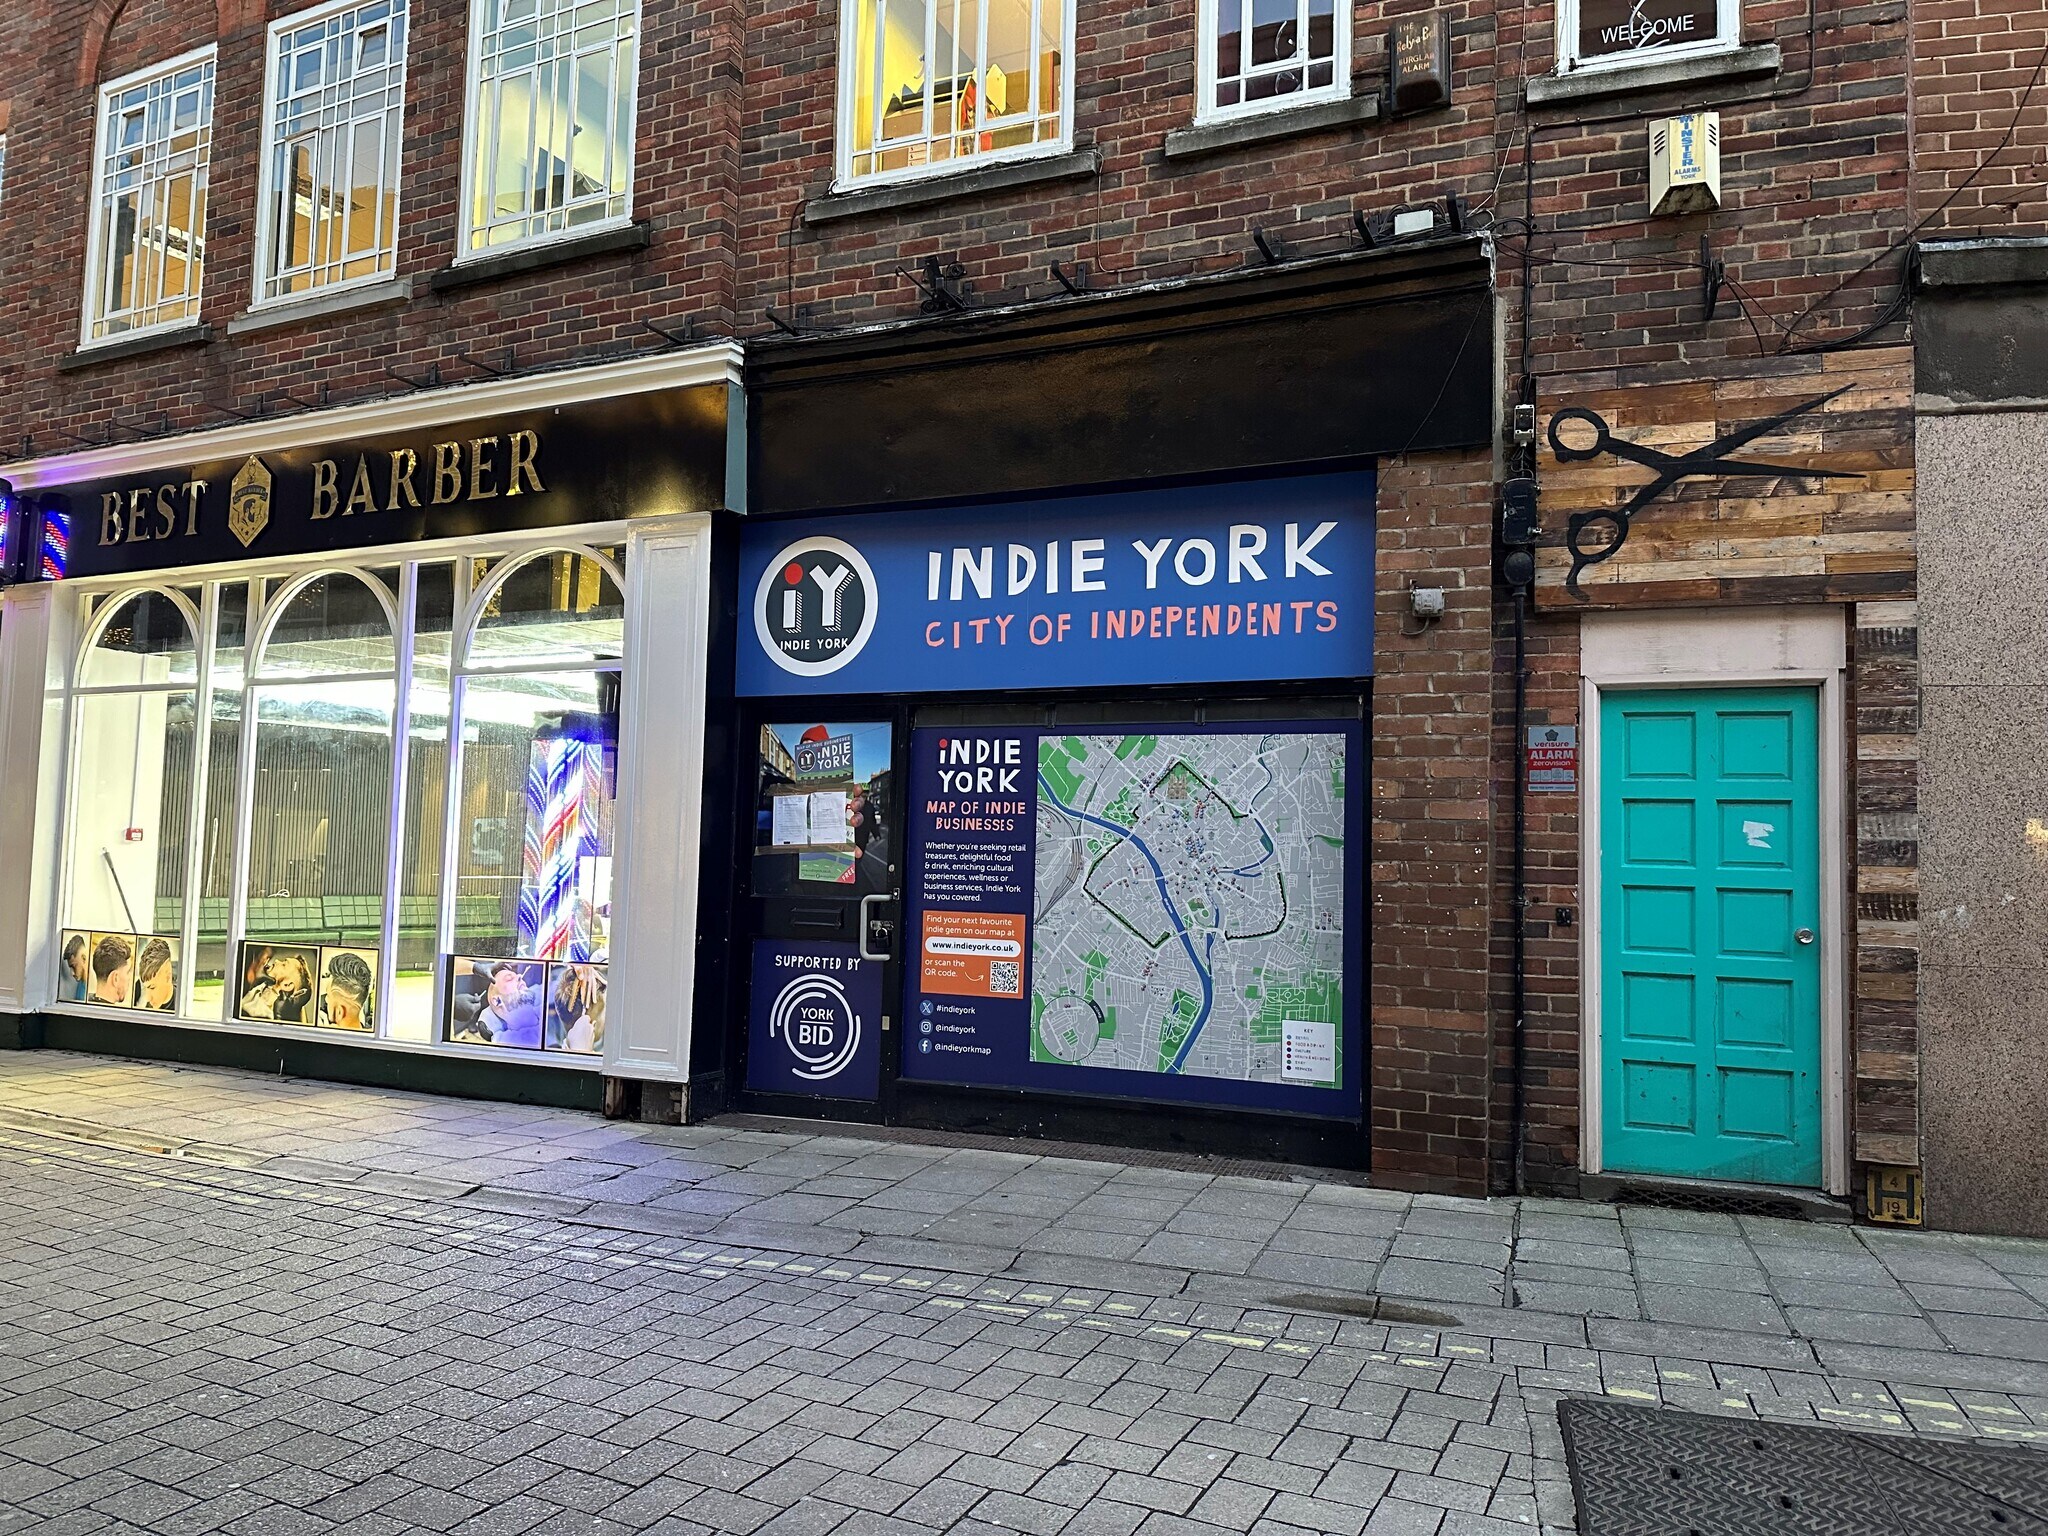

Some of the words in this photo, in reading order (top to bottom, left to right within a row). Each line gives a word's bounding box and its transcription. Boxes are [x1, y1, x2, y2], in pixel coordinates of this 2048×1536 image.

[1399, 22, 1415, 33] THE
[1601, 14, 1695, 44] WELCOME
[1398, 52, 1435, 66] BURGLAR
[1402, 62, 1430, 74] ALARM
[1674, 166, 1701, 176] ALARMS
[98, 479, 208, 546] BEST
[310, 429, 546, 520] BARBER
[928, 538, 1106, 601] INDIE
[1131, 521, 1339, 590] YORK
[925, 614, 1015, 649] CITY
[1028, 614, 1071, 646] OF
[1090, 600, 1338, 640] INDEPENDENTS
[780, 639, 810, 651] INDIE
[817, 637, 849, 650] YORK
[1530, 750, 1574, 760] ALARM
[817, 754, 851, 770] YORK
[938, 767, 1021, 793] YORK
[926, 800, 956, 814] MAP
[960, 801, 979, 815] OF
[985, 802, 1026, 815] INDIE
[935, 818, 1014, 831] BUSINESSES
[925, 841, 955, 850] Whether
[956, 843, 978, 851] you're
[979, 843, 1007, 853] seeking
[925, 852, 958, 860] treasures,
[959, 853, 993, 862] delightful
[994, 853, 1012, 861] food
[931, 862, 950, 871] drink,
[952, 862, 985, 872] enriching
[986, 864, 1014, 872] cultural
[841, 867, 855, 882] FREE
[924, 872, 967, 881] experiences,
[969, 873, 999, 882] wellness
[924, 882, 953, 890] business
[954, 883, 984, 892] services,
[985, 884, 1003, 892] Indie
[1004, 884, 1021, 893] York
[923, 892, 936, 900] has
[936, 893, 950, 902] you
[951, 894, 982, 902] covered.
[926, 915, 942, 923] Find
[943, 916, 960, 925] your
[979, 917, 1012, 926] favourite
[925, 925, 944, 933] indie
[945, 927, 962, 935] gem
[963, 927, 973, 935] on
[989, 928, 1006, 937] map
[1007, 929, 1015, 937] at
[932, 941, 1014, 952] www.indieyork.co.uk
[775, 954, 842, 970] SUPPORTED
[847, 957, 861, 971] BY
[934, 959, 951, 967] scan
[952, 959, 965, 967] the
[924, 968, 937, 976] QR
[938, 968, 958, 977] code.
[800, 1007, 834, 1021] YORK
[936, 1004, 976, 1016] #indieyork
[799, 1024, 834, 1046] BID
[935, 1023, 976, 1035] @indieyork
[934, 1043, 992, 1055] @indieyorkmap
[1890, 1177, 1899, 1187] 4
[1887, 1201, 1900, 1213] 19
